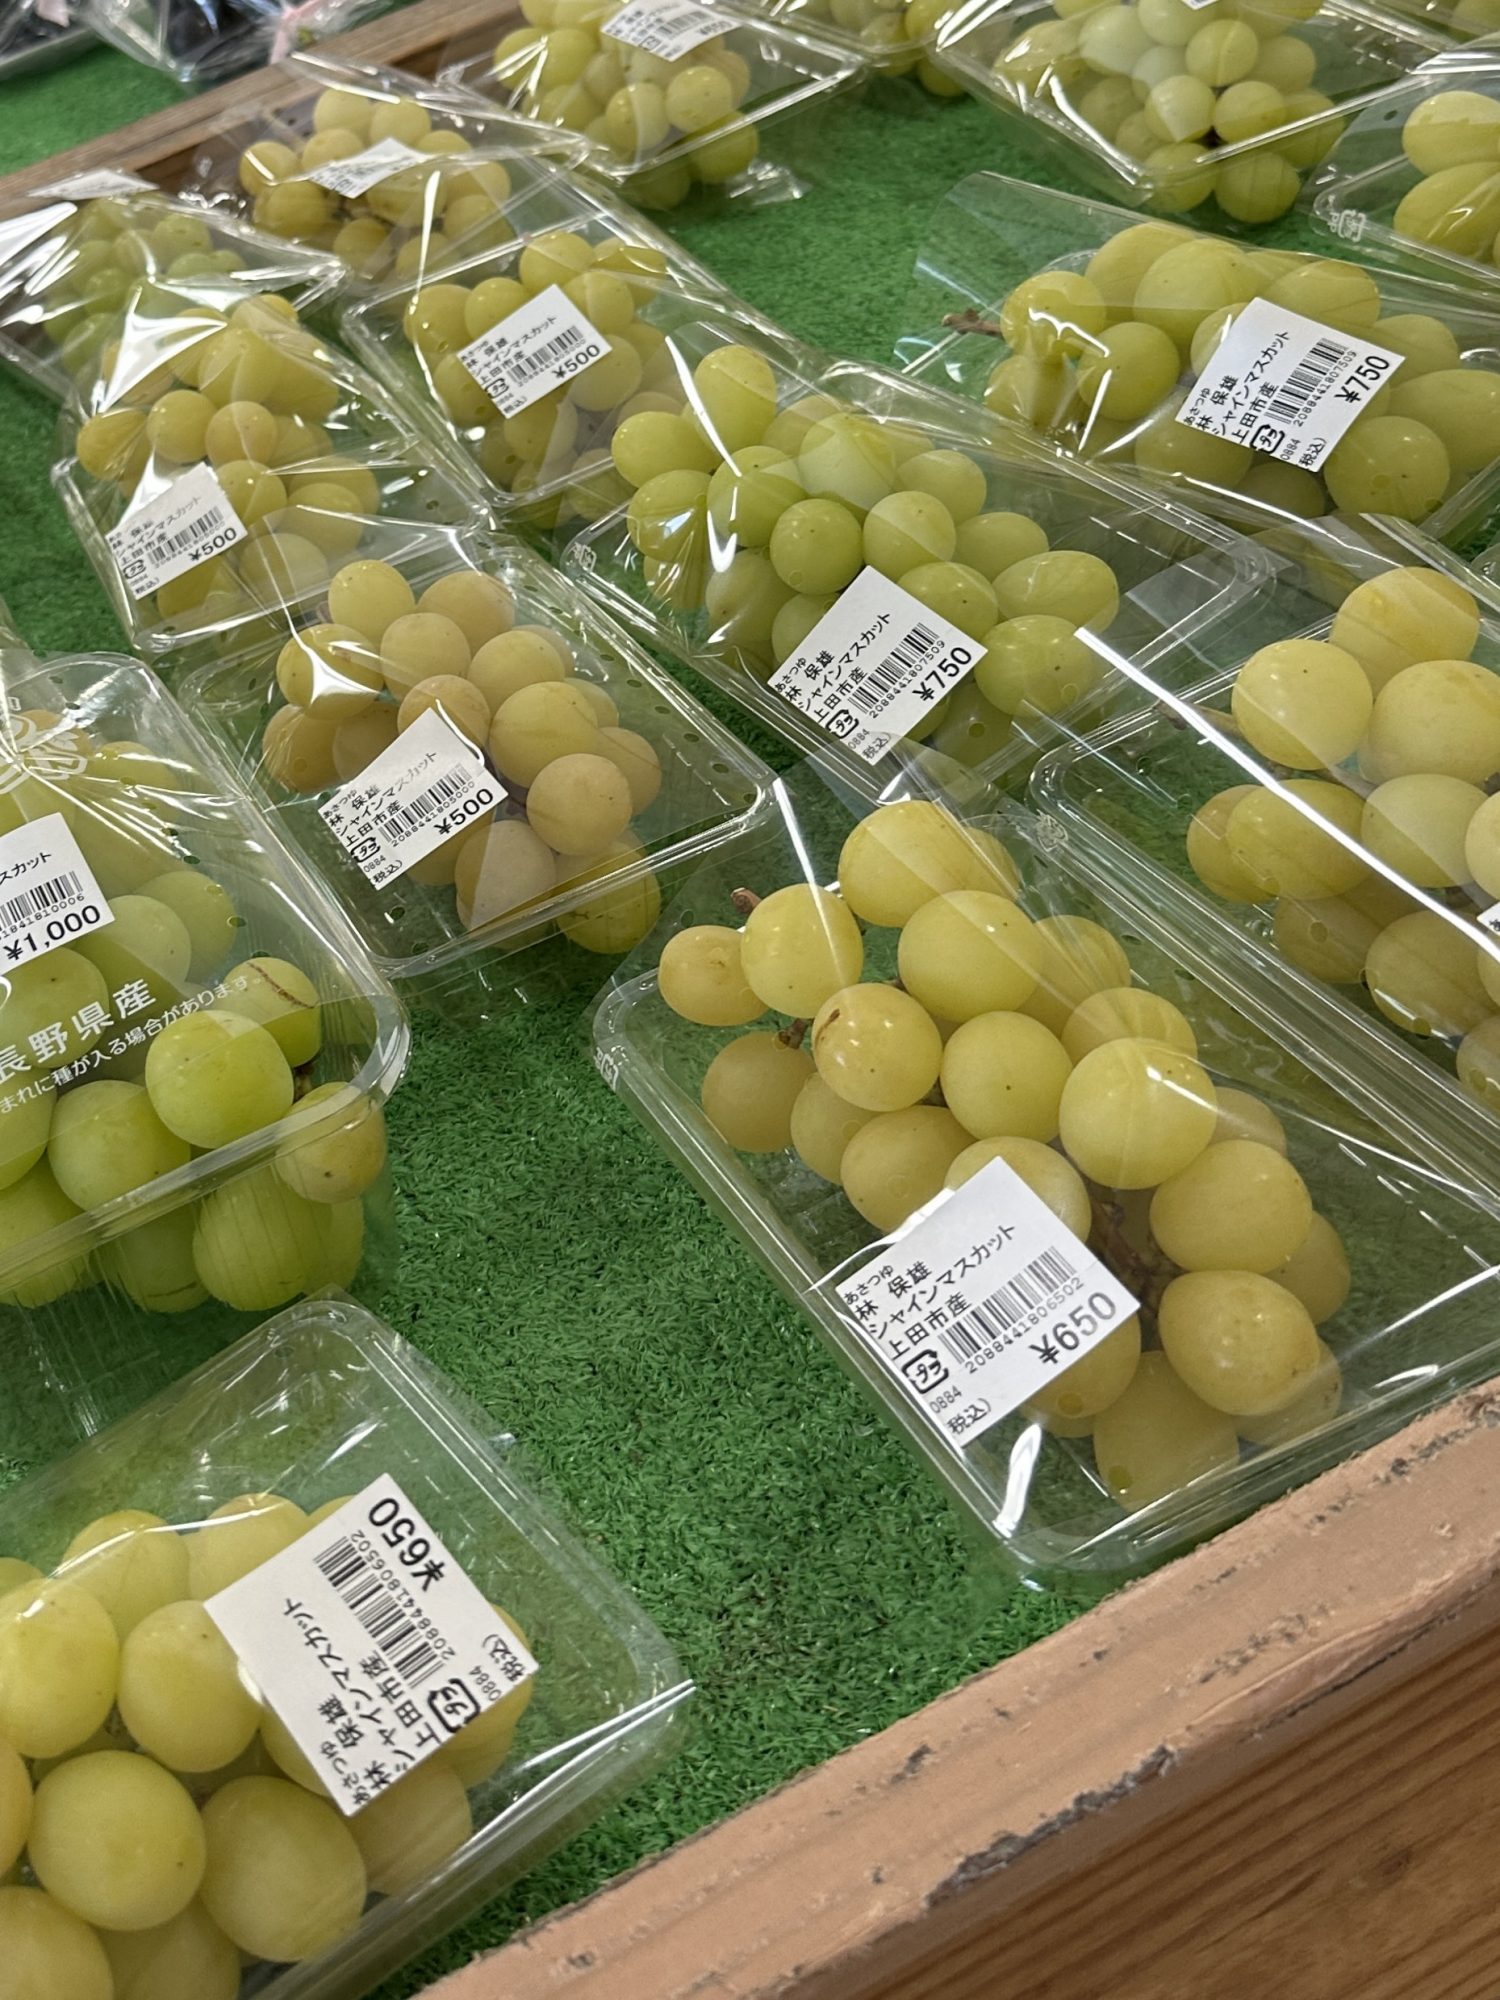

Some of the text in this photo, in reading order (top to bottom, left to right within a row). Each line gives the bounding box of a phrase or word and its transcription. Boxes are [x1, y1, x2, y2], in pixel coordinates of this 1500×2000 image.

[550, 343, 601, 379] ¥500
[1207, 331, 1291, 438] シャインマスカット
[1292, 347, 1357, 428] 2088441807509
[1333, 354, 1392, 405] ¥750
[1180, 387, 1212, 426] あさつゆ
[1193, 374, 1239, 432] 林 保雄
[1226, 380, 1283, 444] 上田市産
[1276, 437, 1302, 462] 0884
[187, 526, 238, 562] ¥500
[772, 656, 807, 694] あさつゆ
[782, 649, 836, 704] 林 保雄
[796, 608, 895, 714] シャインマスカット
[868, 639, 946, 719] 2088441807509
[910, 643, 973, 702] ¥750
[813, 664, 869, 725] 上田市産
[845, 727, 871, 750] 0884
[321, 788, 358, 820] あさつゆ
[328, 812, 345, 828] 林
[335, 750, 437, 838] シャインマスカット
[390, 780, 475, 848] 2088441805000
[432, 787, 494, 838] ¥500
[342, 799, 404, 852] 上田市産
[362, 853, 387, 873] 0884
[3, 905, 101, 961] ¥1,000
[0, 978, 157, 1085] 長野県産
[841, 1264, 895, 1309] あさつゆ
[853, 1259, 933, 1326] 林 保雄
[866, 1224, 1016, 1347] シャインマスカット
[881, 1289, 973, 1367] 上田市産
[963, 1276, 1085, 1375] 2088441806502
[1027, 1291, 1117, 1366] ¥650
[928, 1384, 963, 1415] 0884
[366, 1496, 448, 1593] ¥650
[349, 1528, 457, 1661] 2088441806502
[282, 1596, 419, 1777] シャインマスカット
[357, 1649, 443, 1755] 上田市産
[468, 1664, 503, 1703] 0884
[316, 1692, 366, 1750] 保雄
[319, 1739, 373, 1809] あさつゆ
